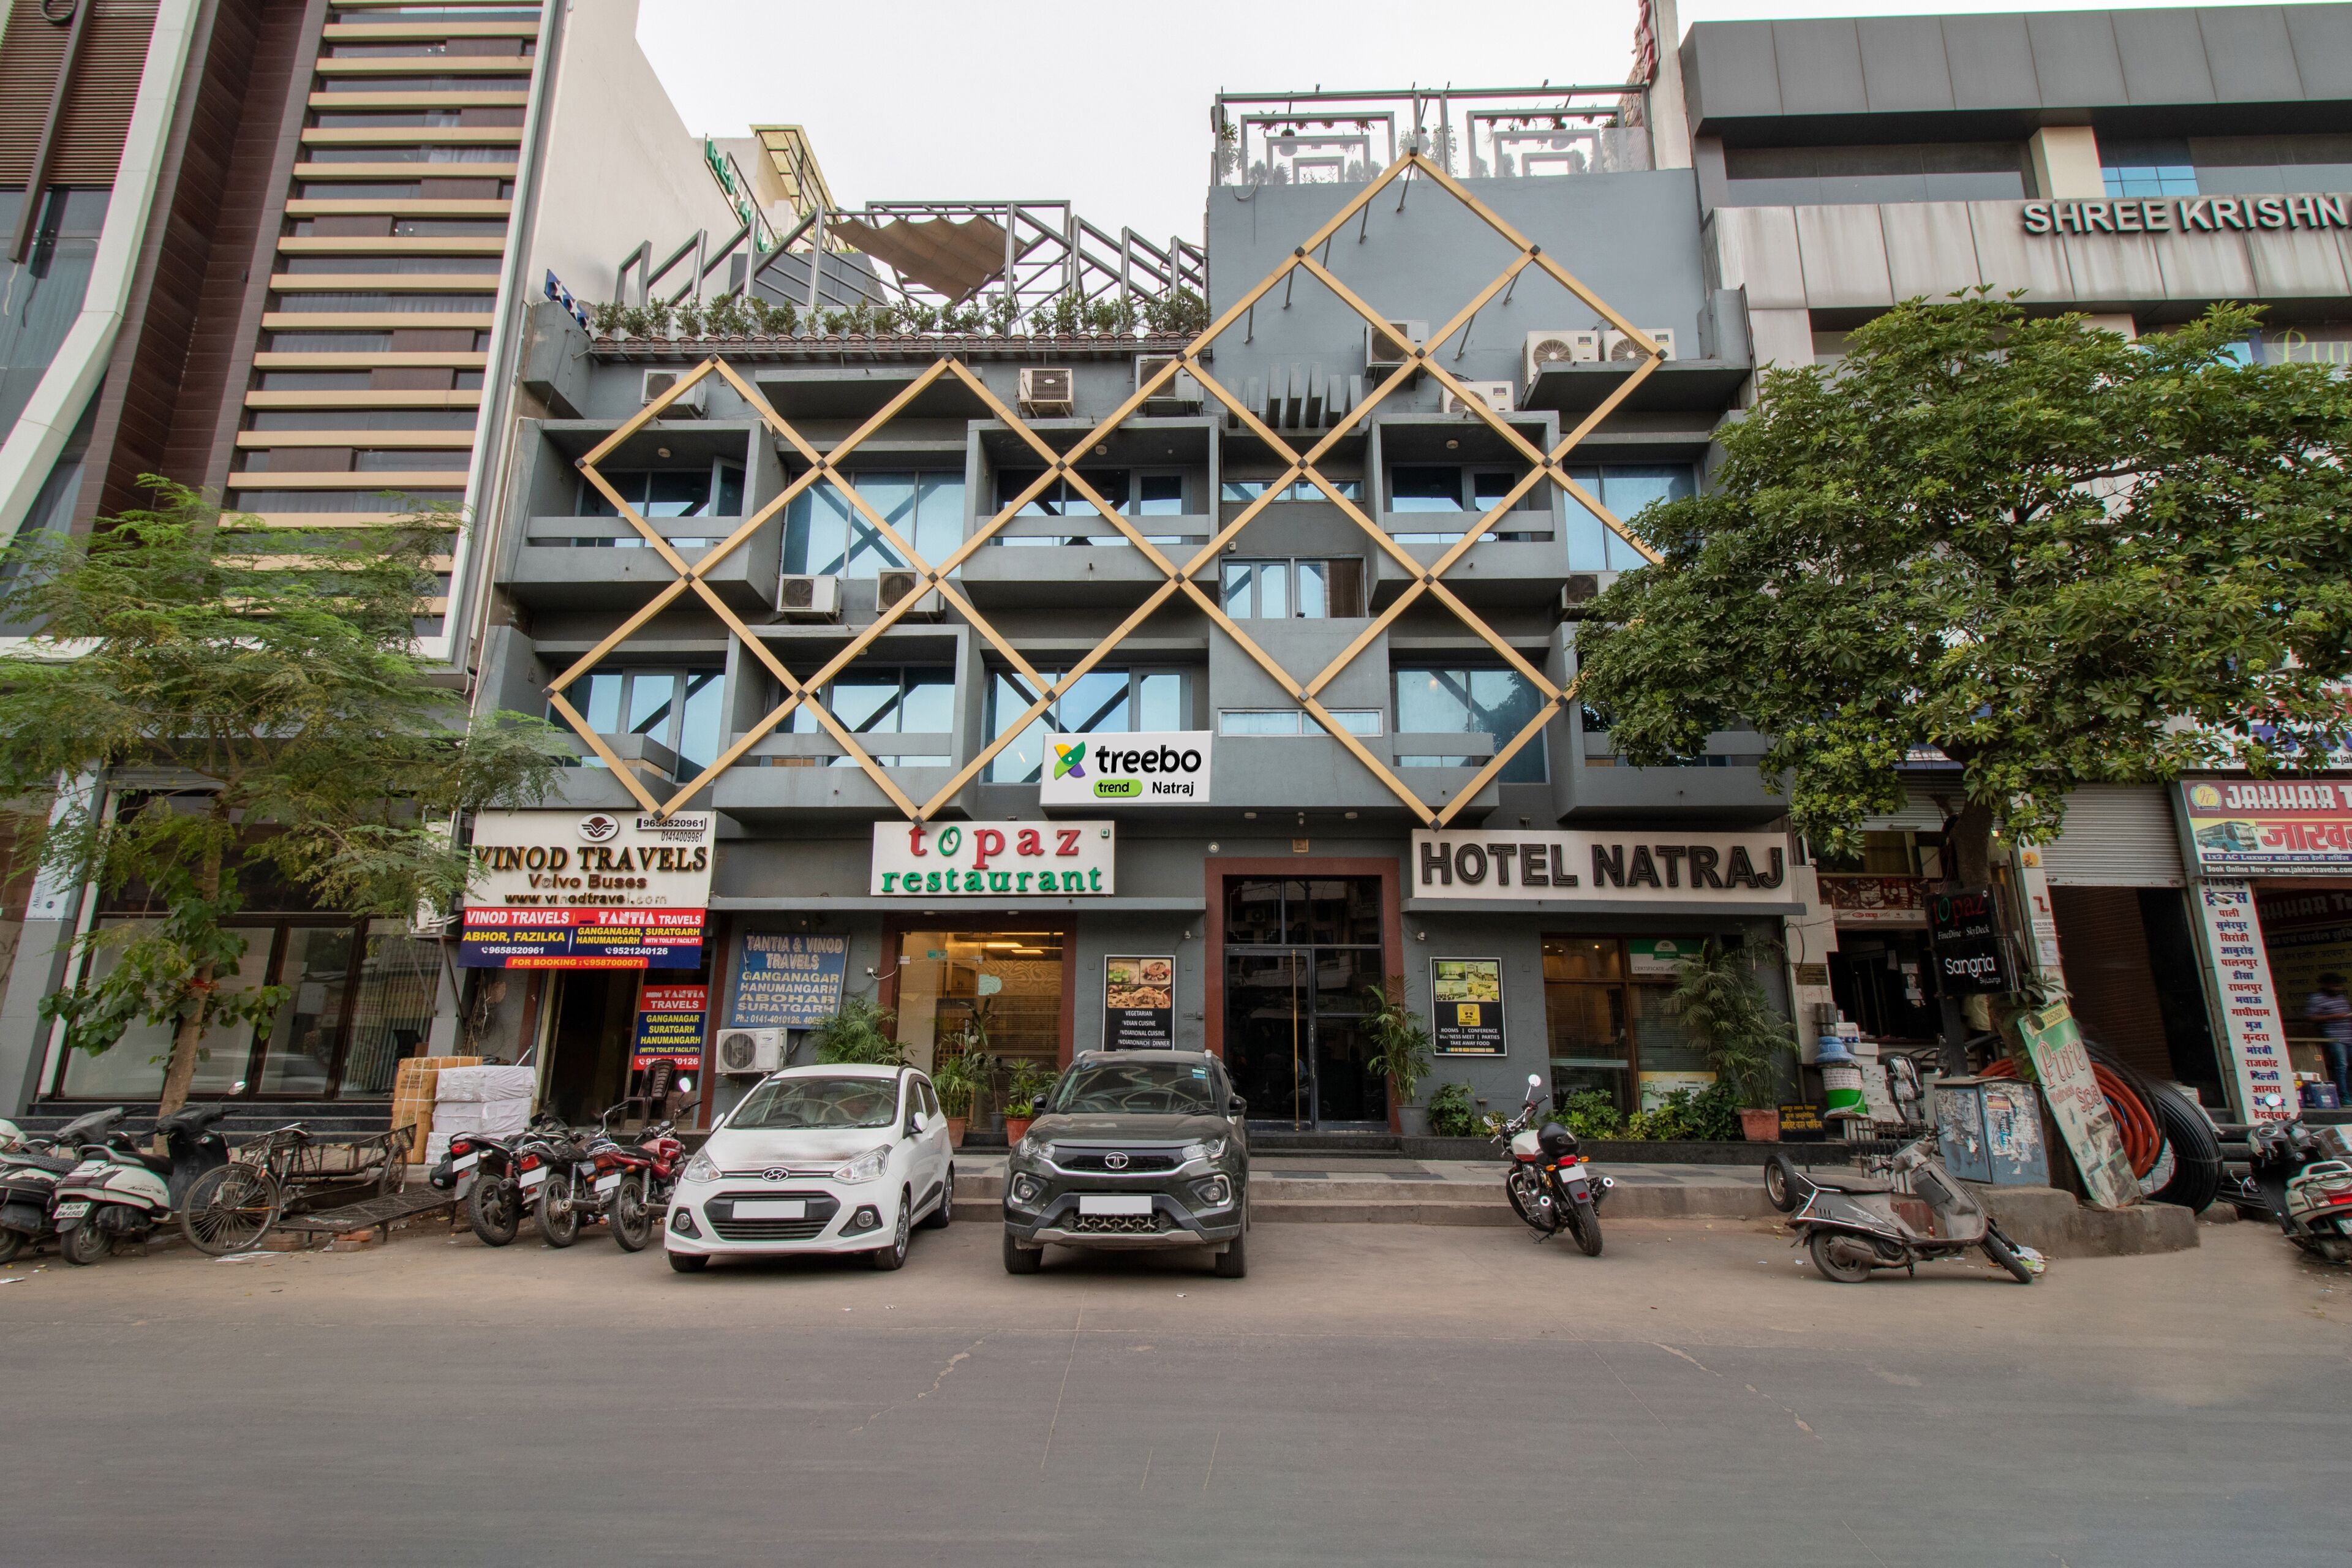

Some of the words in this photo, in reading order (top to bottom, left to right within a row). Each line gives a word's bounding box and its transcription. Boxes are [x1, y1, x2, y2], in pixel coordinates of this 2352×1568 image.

[2023, 200, 2171, 235] SHREE
[2177, 197, 2352, 232] KRISHN
[1095, 744, 1202, 774] treebo
[1098, 781, 1130, 794] trend
[1152, 781, 1195, 797] Natraj
[2225, 786, 2337, 809] JAKHAR
[661, 831, 703, 843] 01414009961
[908, 825, 1081, 869] topaz
[475, 846, 570, 870] VINOD
[577, 846, 708, 871] TRAVELS
[1419, 842, 1579, 886] HOTEL
[1591, 843, 1785, 889] NATRAJ
[529, 873, 581, 889] Volvo
[587, 874, 647, 889] Buses
[882, 867, 1102, 892] restaurant
[467, 911, 508, 924] VINOD
[511, 911, 570, 924] TRAVELS
[598, 911, 655, 924] TANTIA
[658, 915, 701, 925] TRAVELS
[1932, 895, 1986, 927] topaz
[462, 931, 511, 944] ABHOR,
[513, 932, 565, 942] FAZILKA
[578, 927, 643, 937] GANGANAGAR,
[1938, 929, 1962, 940] FineDine
[1966, 924, 1990, 937] SkyDeck
[746, 935, 791, 952] TANTIA
[792, 937, 803, 953] &
[805, 937, 844, 954] VINOD
[766, 952, 820, 970] TRAVELS
[1945, 952, 1997, 978] Sangria
[741, 971, 840, 983] GANGANAGAR
[739, 982, 838, 993] HANUMANGARH
[650, 1000, 699, 1009] TRAVELS
[738, 993, 837, 1003] ABOHAR
[737, 1002, 835, 1013] SURATGARH
[2037, 1035, 2086, 1090] Pure
